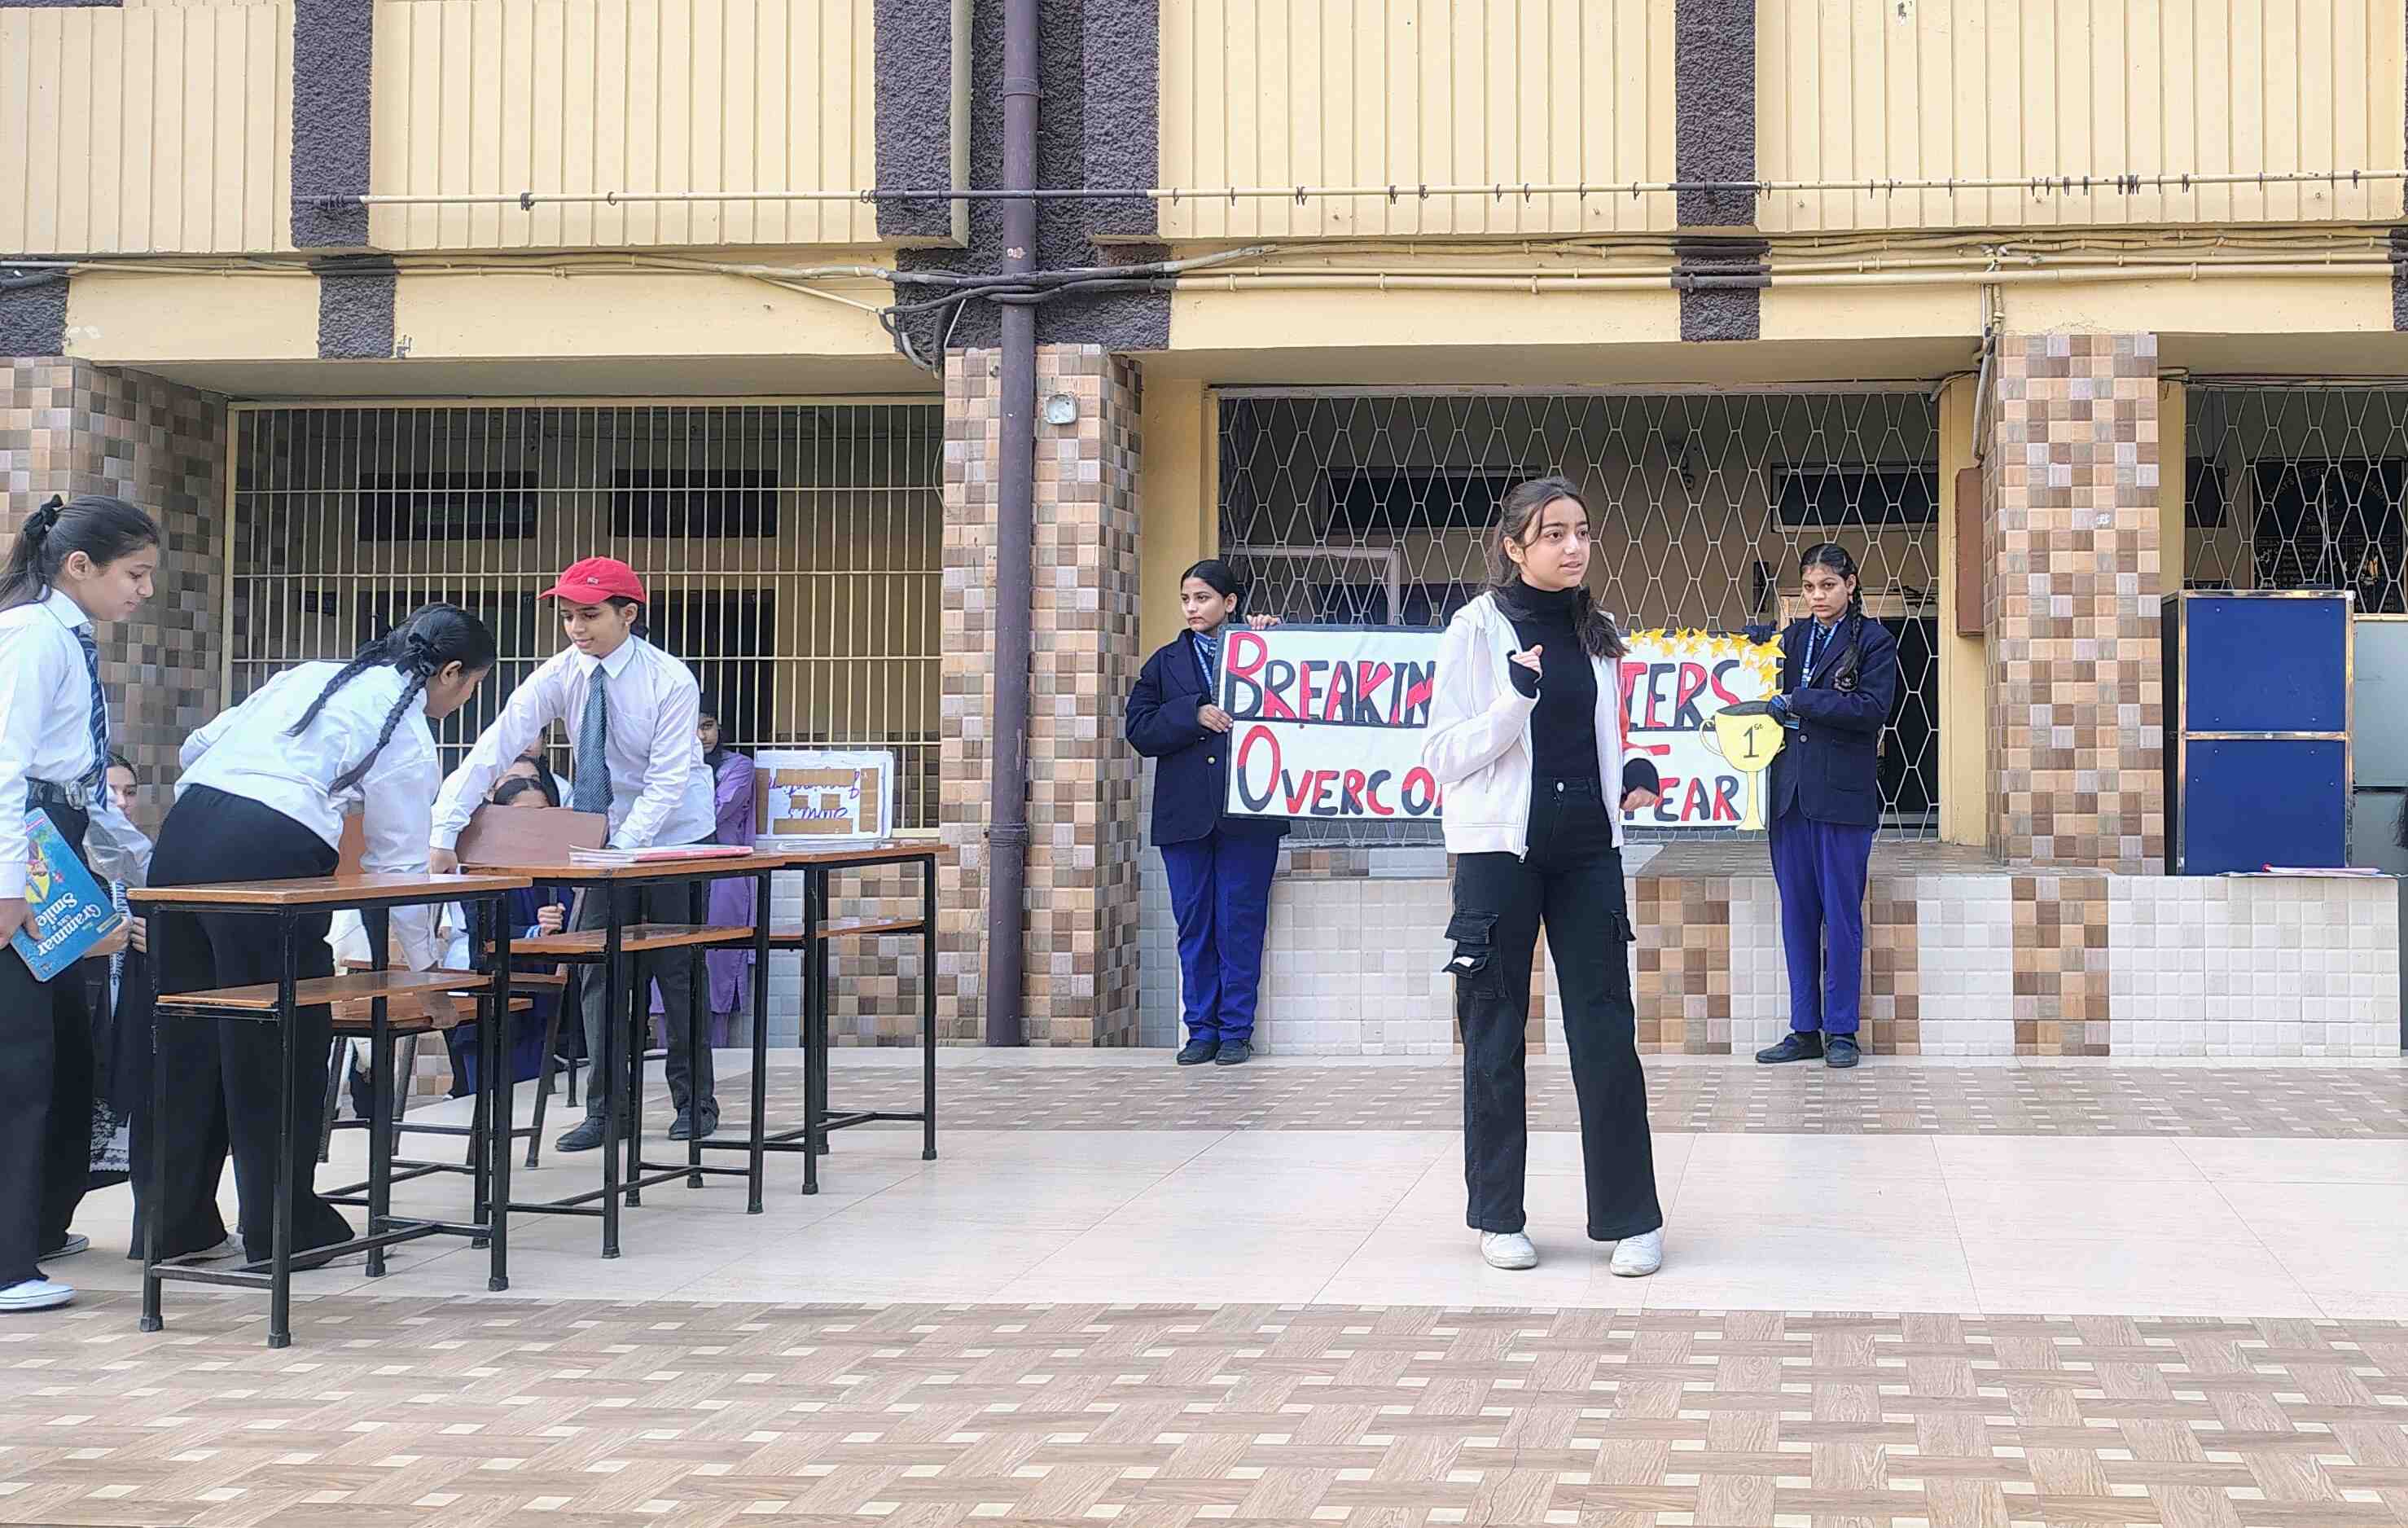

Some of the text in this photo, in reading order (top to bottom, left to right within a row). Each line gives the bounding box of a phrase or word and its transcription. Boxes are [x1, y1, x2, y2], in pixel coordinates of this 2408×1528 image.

[1224, 631, 1436, 726] BREAKIN
[1743, 722, 1764, 758] 1st
[1237, 725, 1442, 816] OVERCO
[35, 892, 77, 926] Smile
[37, 904, 101, 956] Grammar
